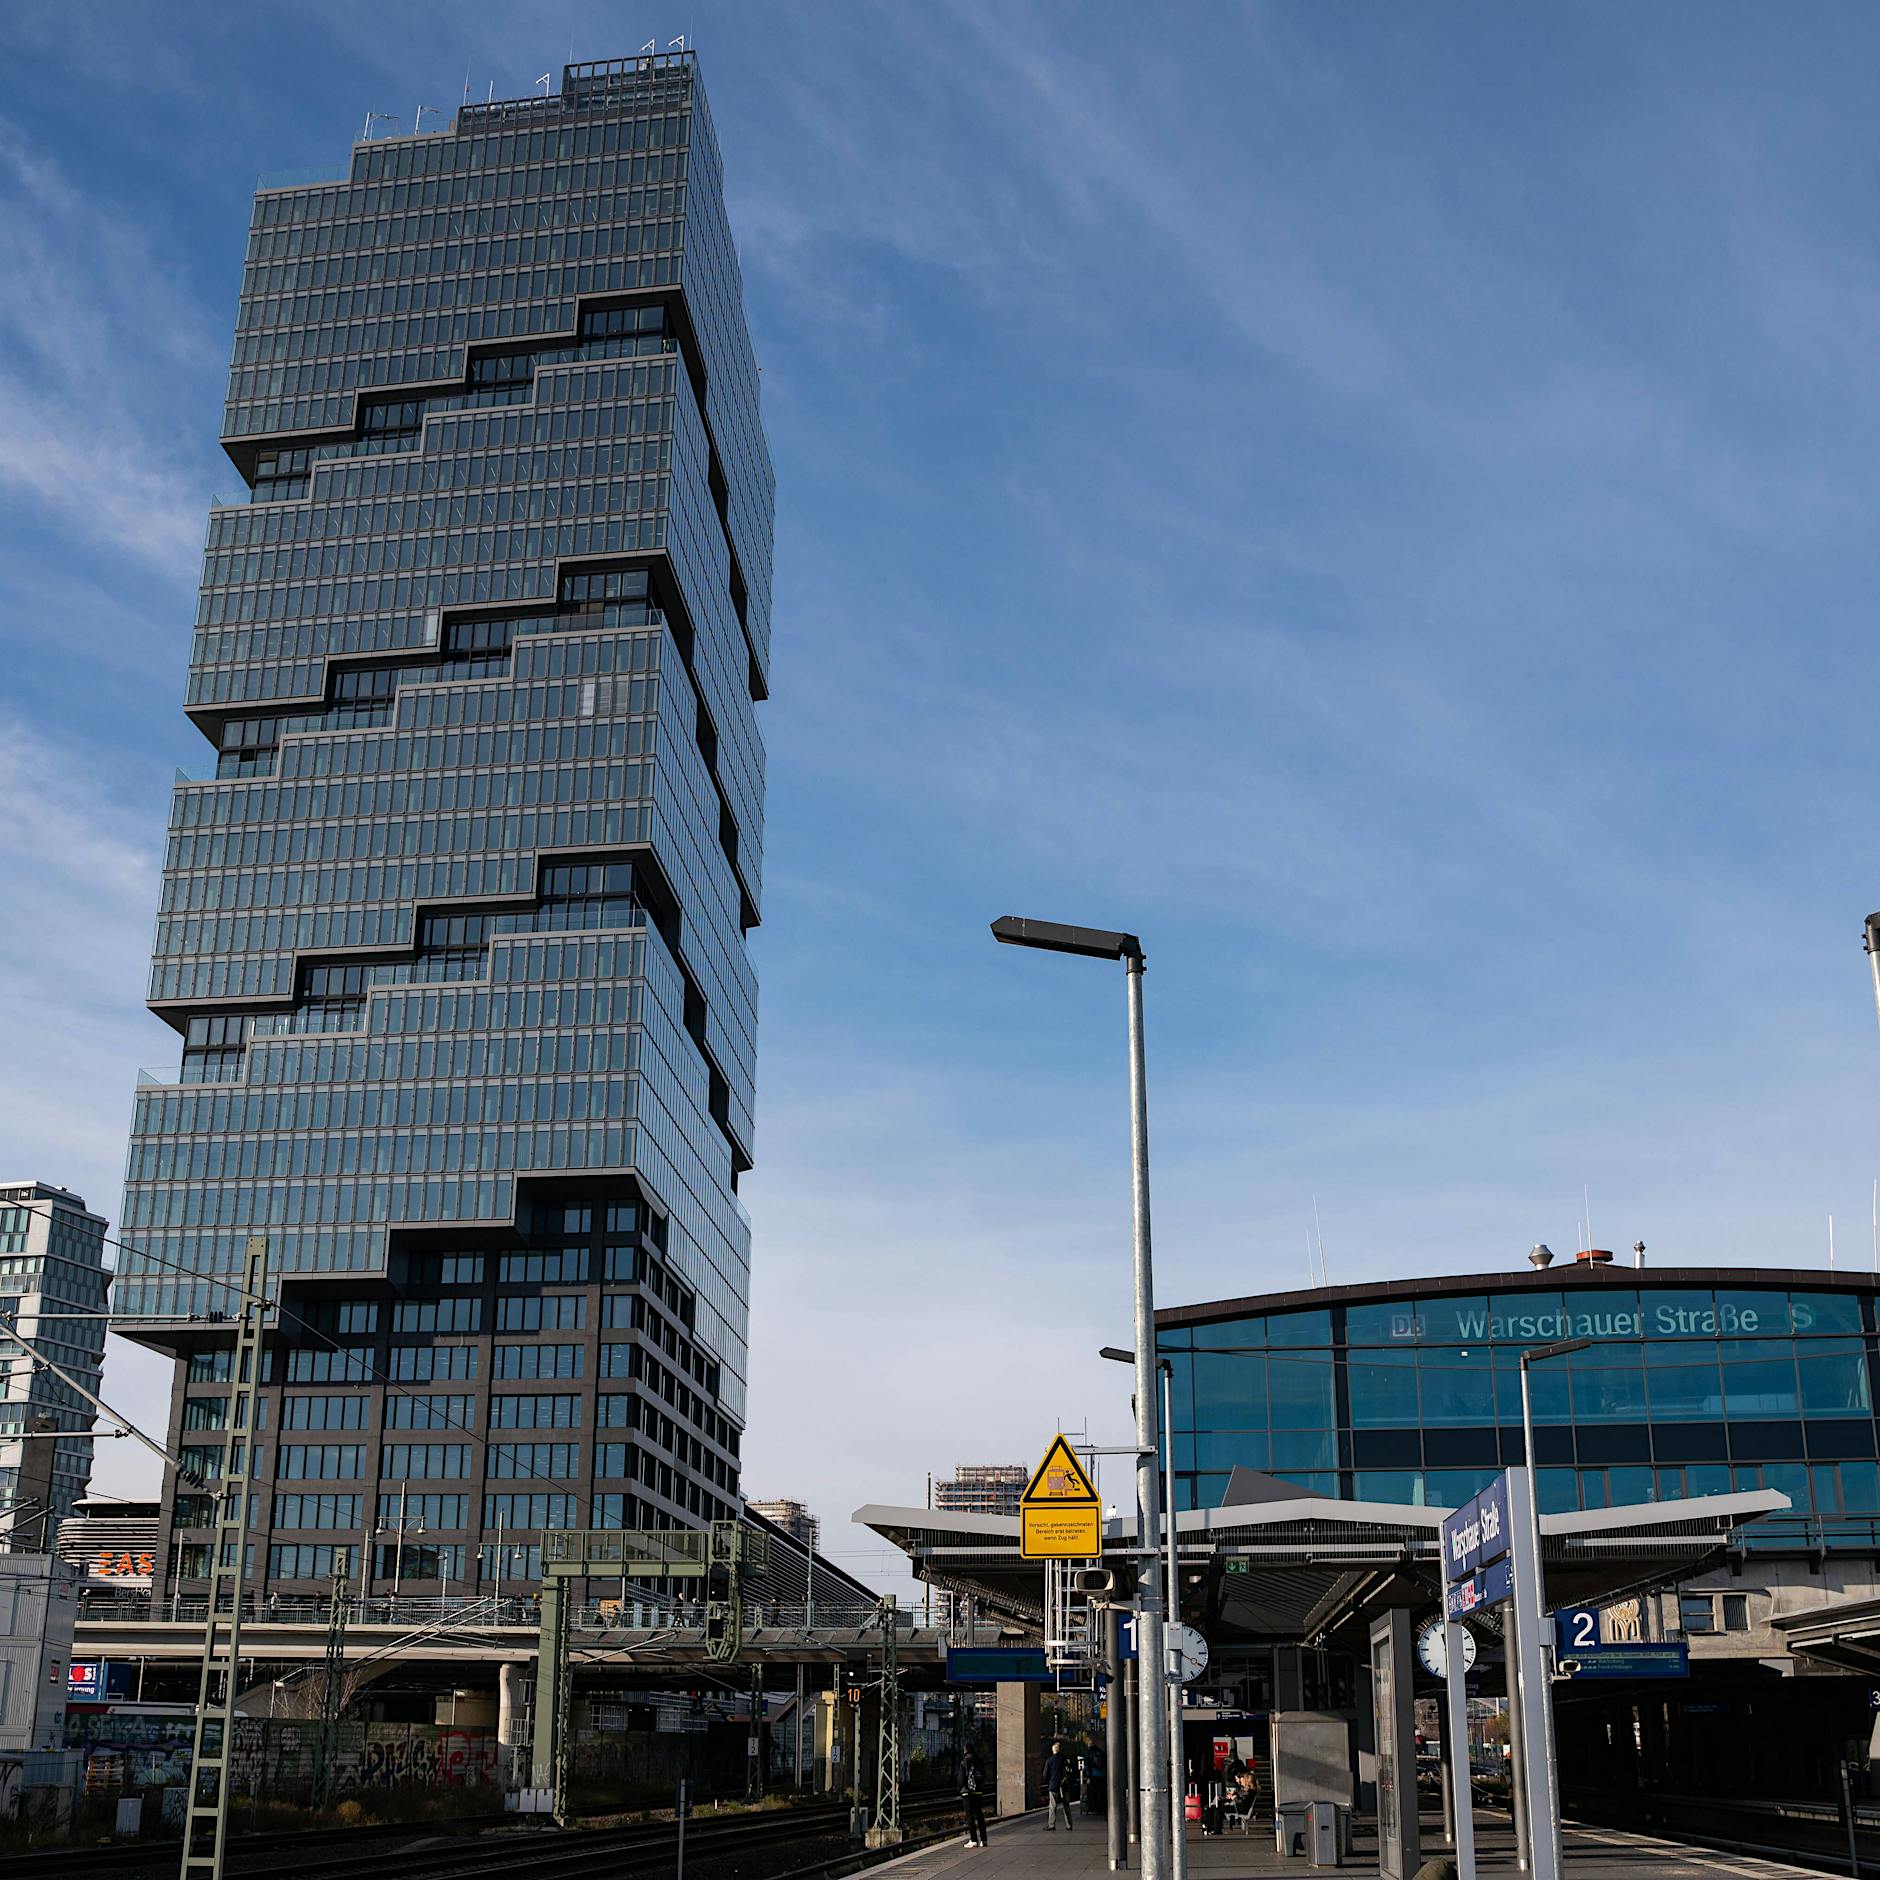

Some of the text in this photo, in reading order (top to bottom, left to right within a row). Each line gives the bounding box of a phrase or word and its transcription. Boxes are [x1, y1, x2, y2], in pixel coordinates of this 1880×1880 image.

[1456, 1308, 1645, 1339] Warschauer
[1655, 1303, 1760, 1335] Straße
[1123, 1618, 1137, 1651] 1
[1572, 1612, 1596, 1647] 2
[847, 1688, 861, 1702] 10
[1872, 1690, 1880, 1706] 3
